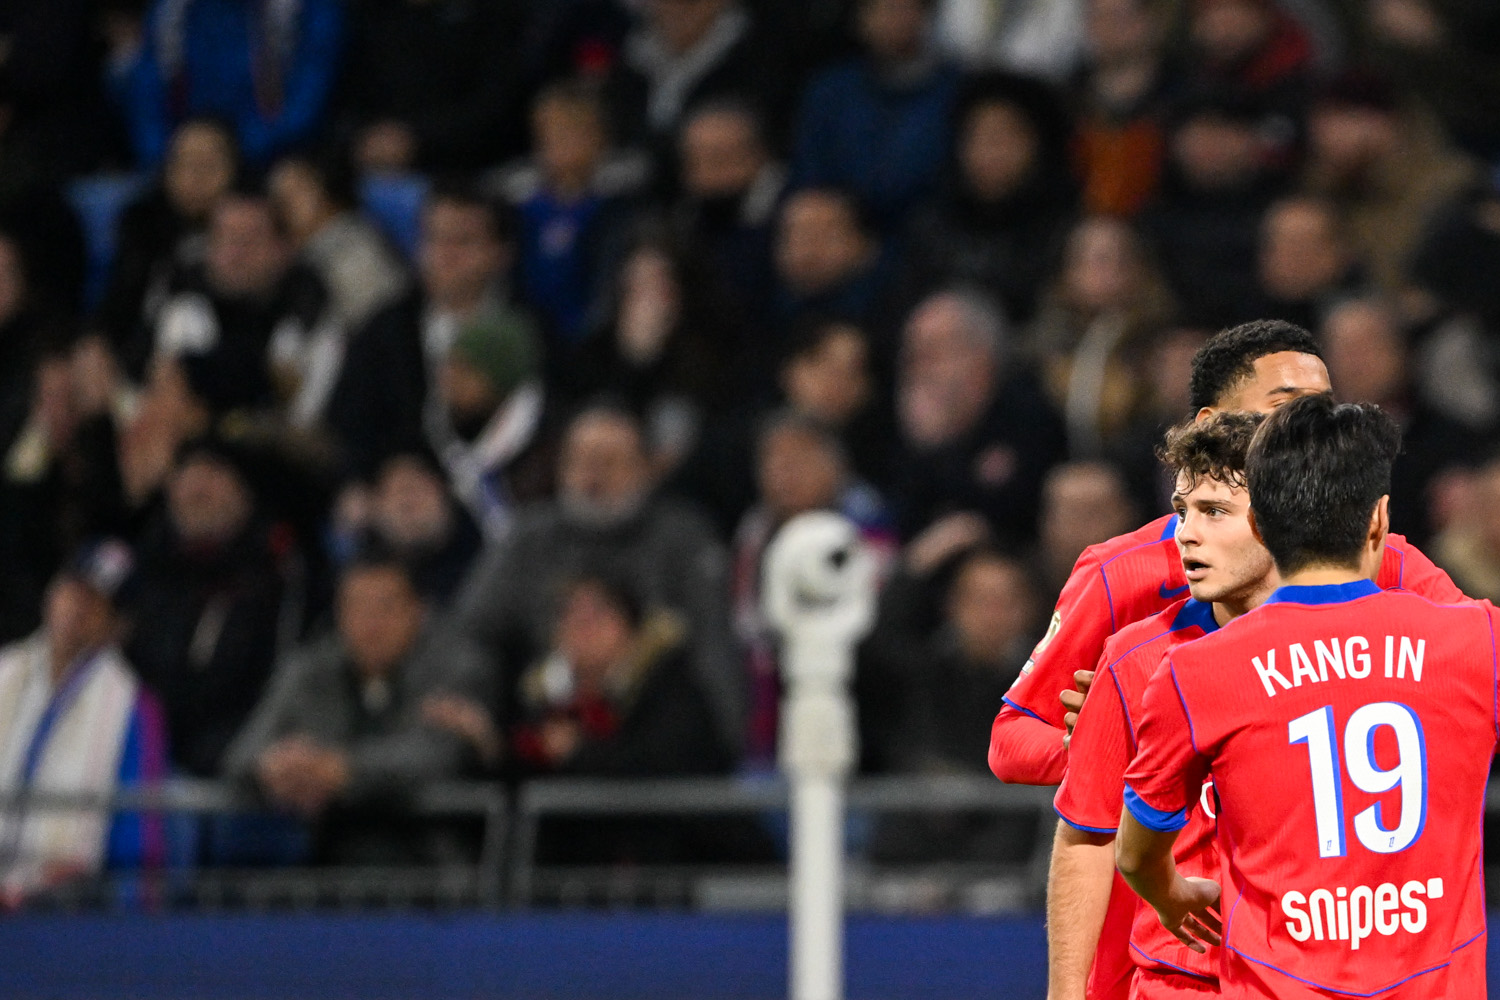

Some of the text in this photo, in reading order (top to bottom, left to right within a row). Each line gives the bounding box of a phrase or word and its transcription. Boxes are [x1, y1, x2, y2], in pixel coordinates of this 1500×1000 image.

[1251, 635, 1426, 698] KANG IN
[1288, 701, 1428, 859] 19
[1281, 879, 1428, 950] snipes
